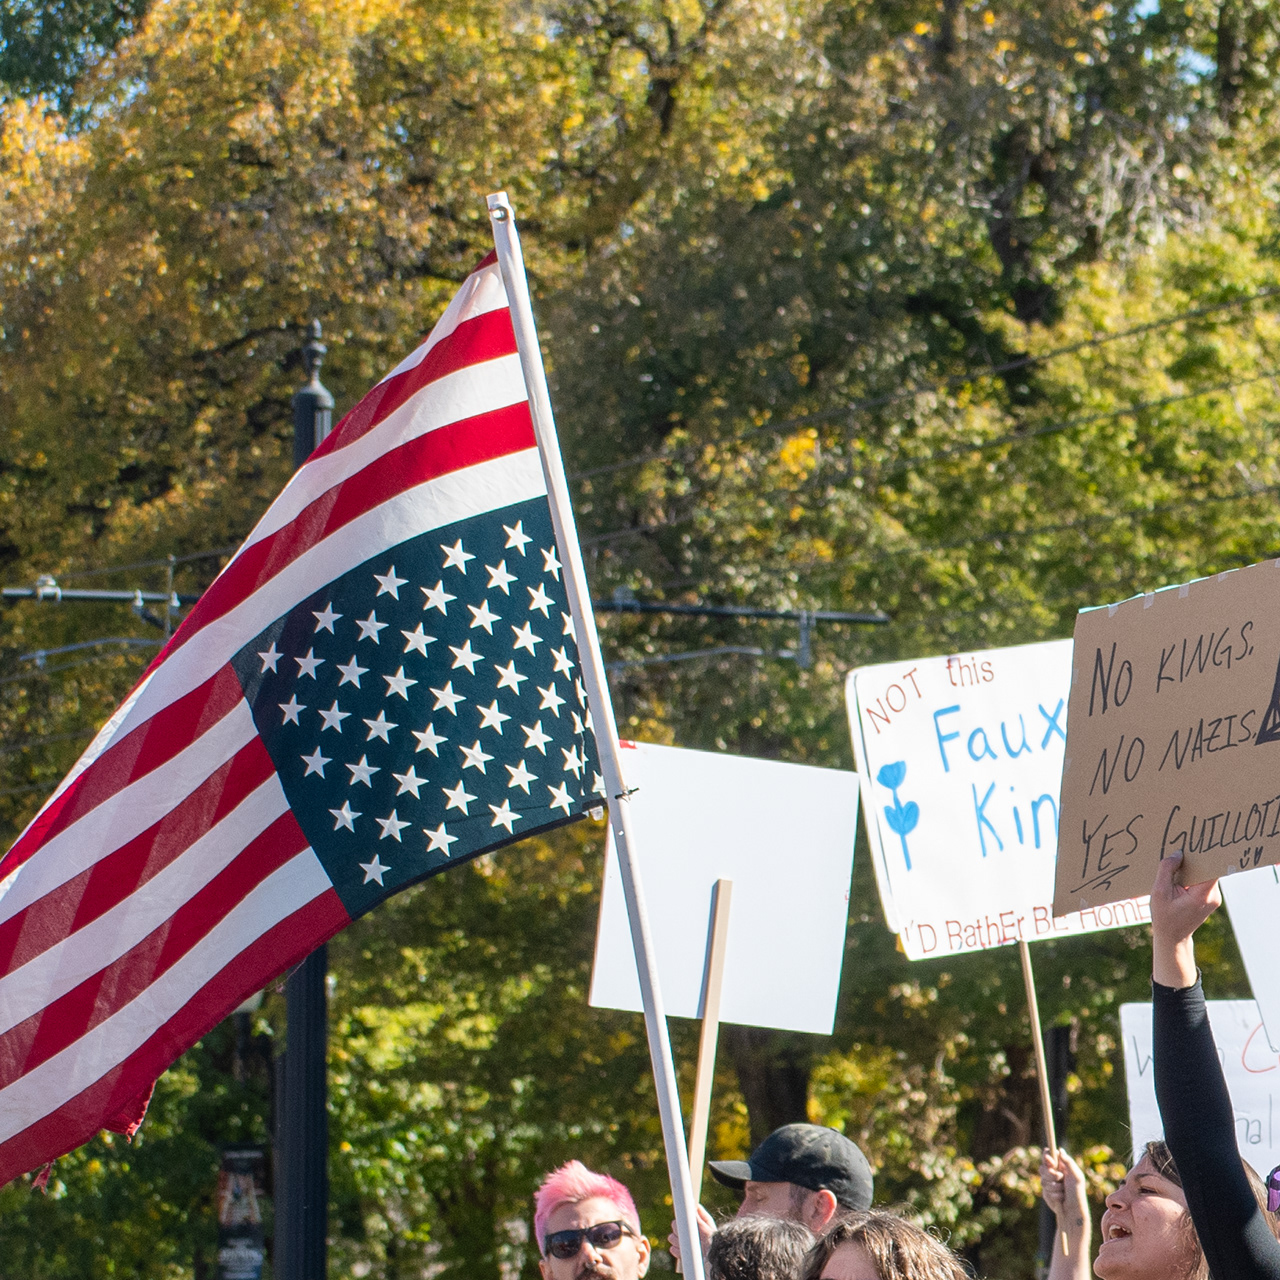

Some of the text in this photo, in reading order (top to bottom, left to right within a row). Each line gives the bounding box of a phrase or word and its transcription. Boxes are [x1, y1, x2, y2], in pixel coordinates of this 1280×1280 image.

[866, 656, 995, 734] NOT this
[1089, 642, 1132, 717] NO
[933, 698, 1066, 773] Faux
[1089, 735, 1145, 796] NO
[972, 781, 1060, 858] Kin
[1082, 814, 1143, 878] YES
